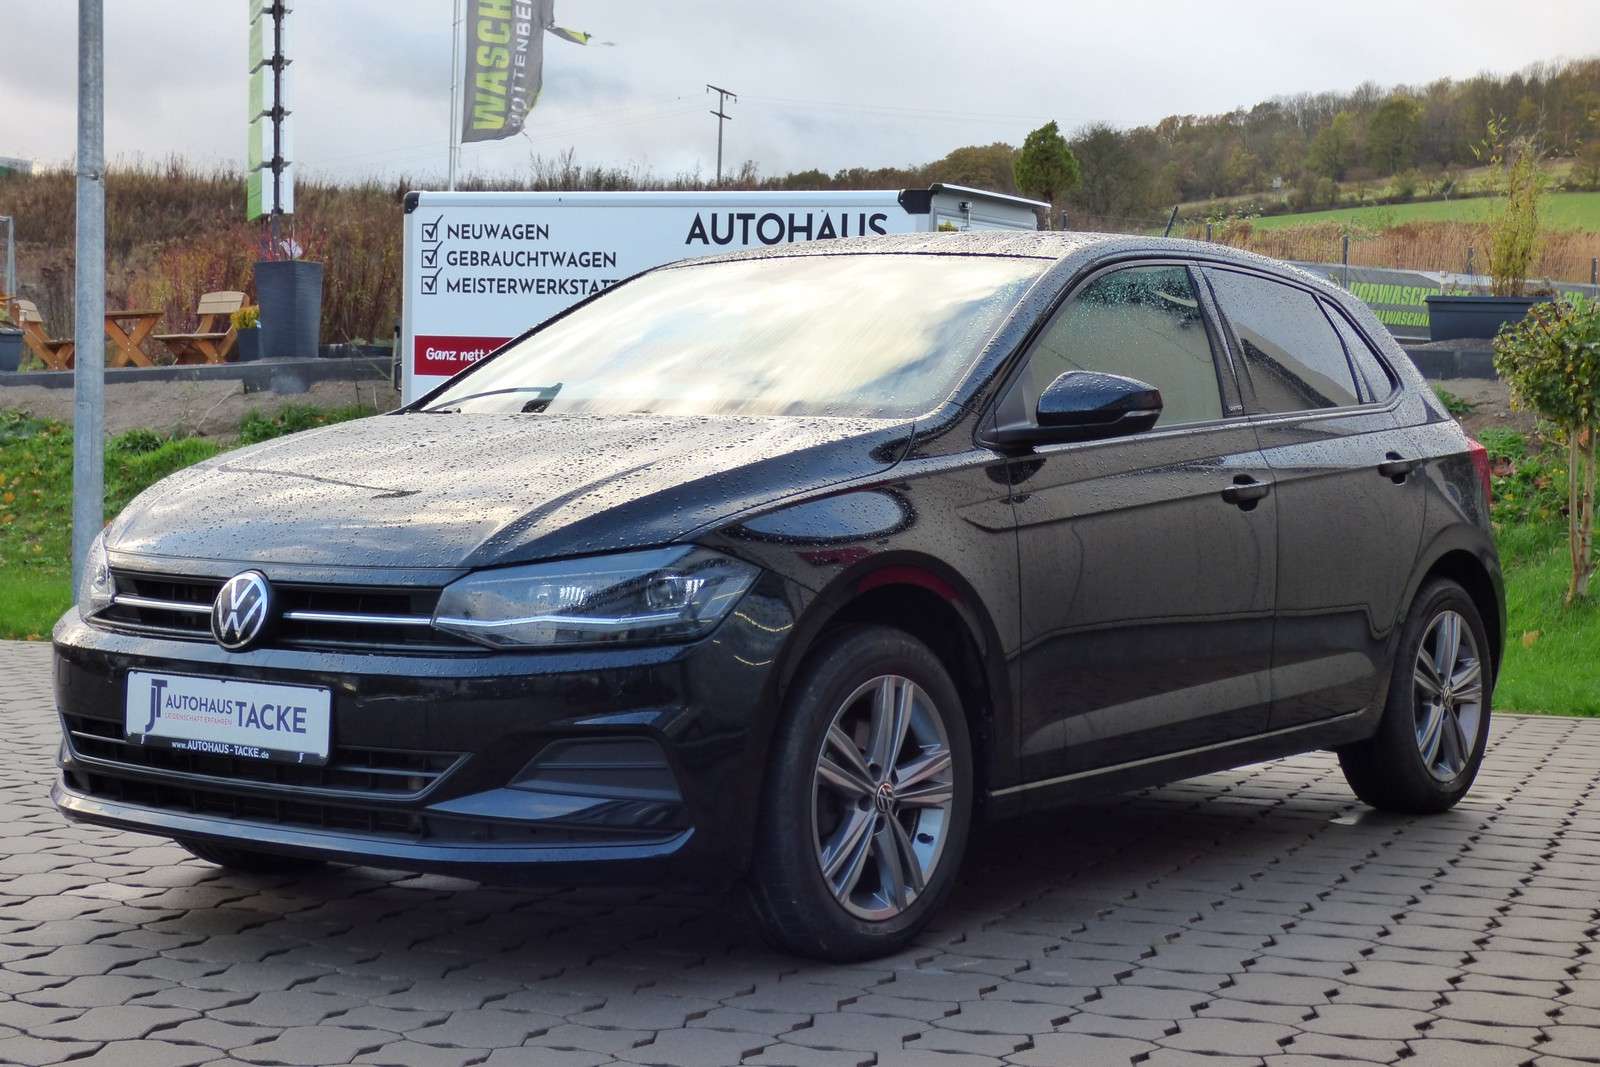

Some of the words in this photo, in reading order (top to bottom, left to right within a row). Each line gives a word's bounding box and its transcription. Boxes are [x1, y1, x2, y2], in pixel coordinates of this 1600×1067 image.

[447, 224, 549, 240] NEUWAGEN
[685, 212, 888, 245] AUTOHAUS
[447, 250, 616, 268] GEBRAUCHTWAGEN
[426, 347, 457, 361] Ganz
[460, 348, 485, 361] nett
[166, 694, 233, 714] AUTOHAUS
[235, 701, 307, 734] TACKE
